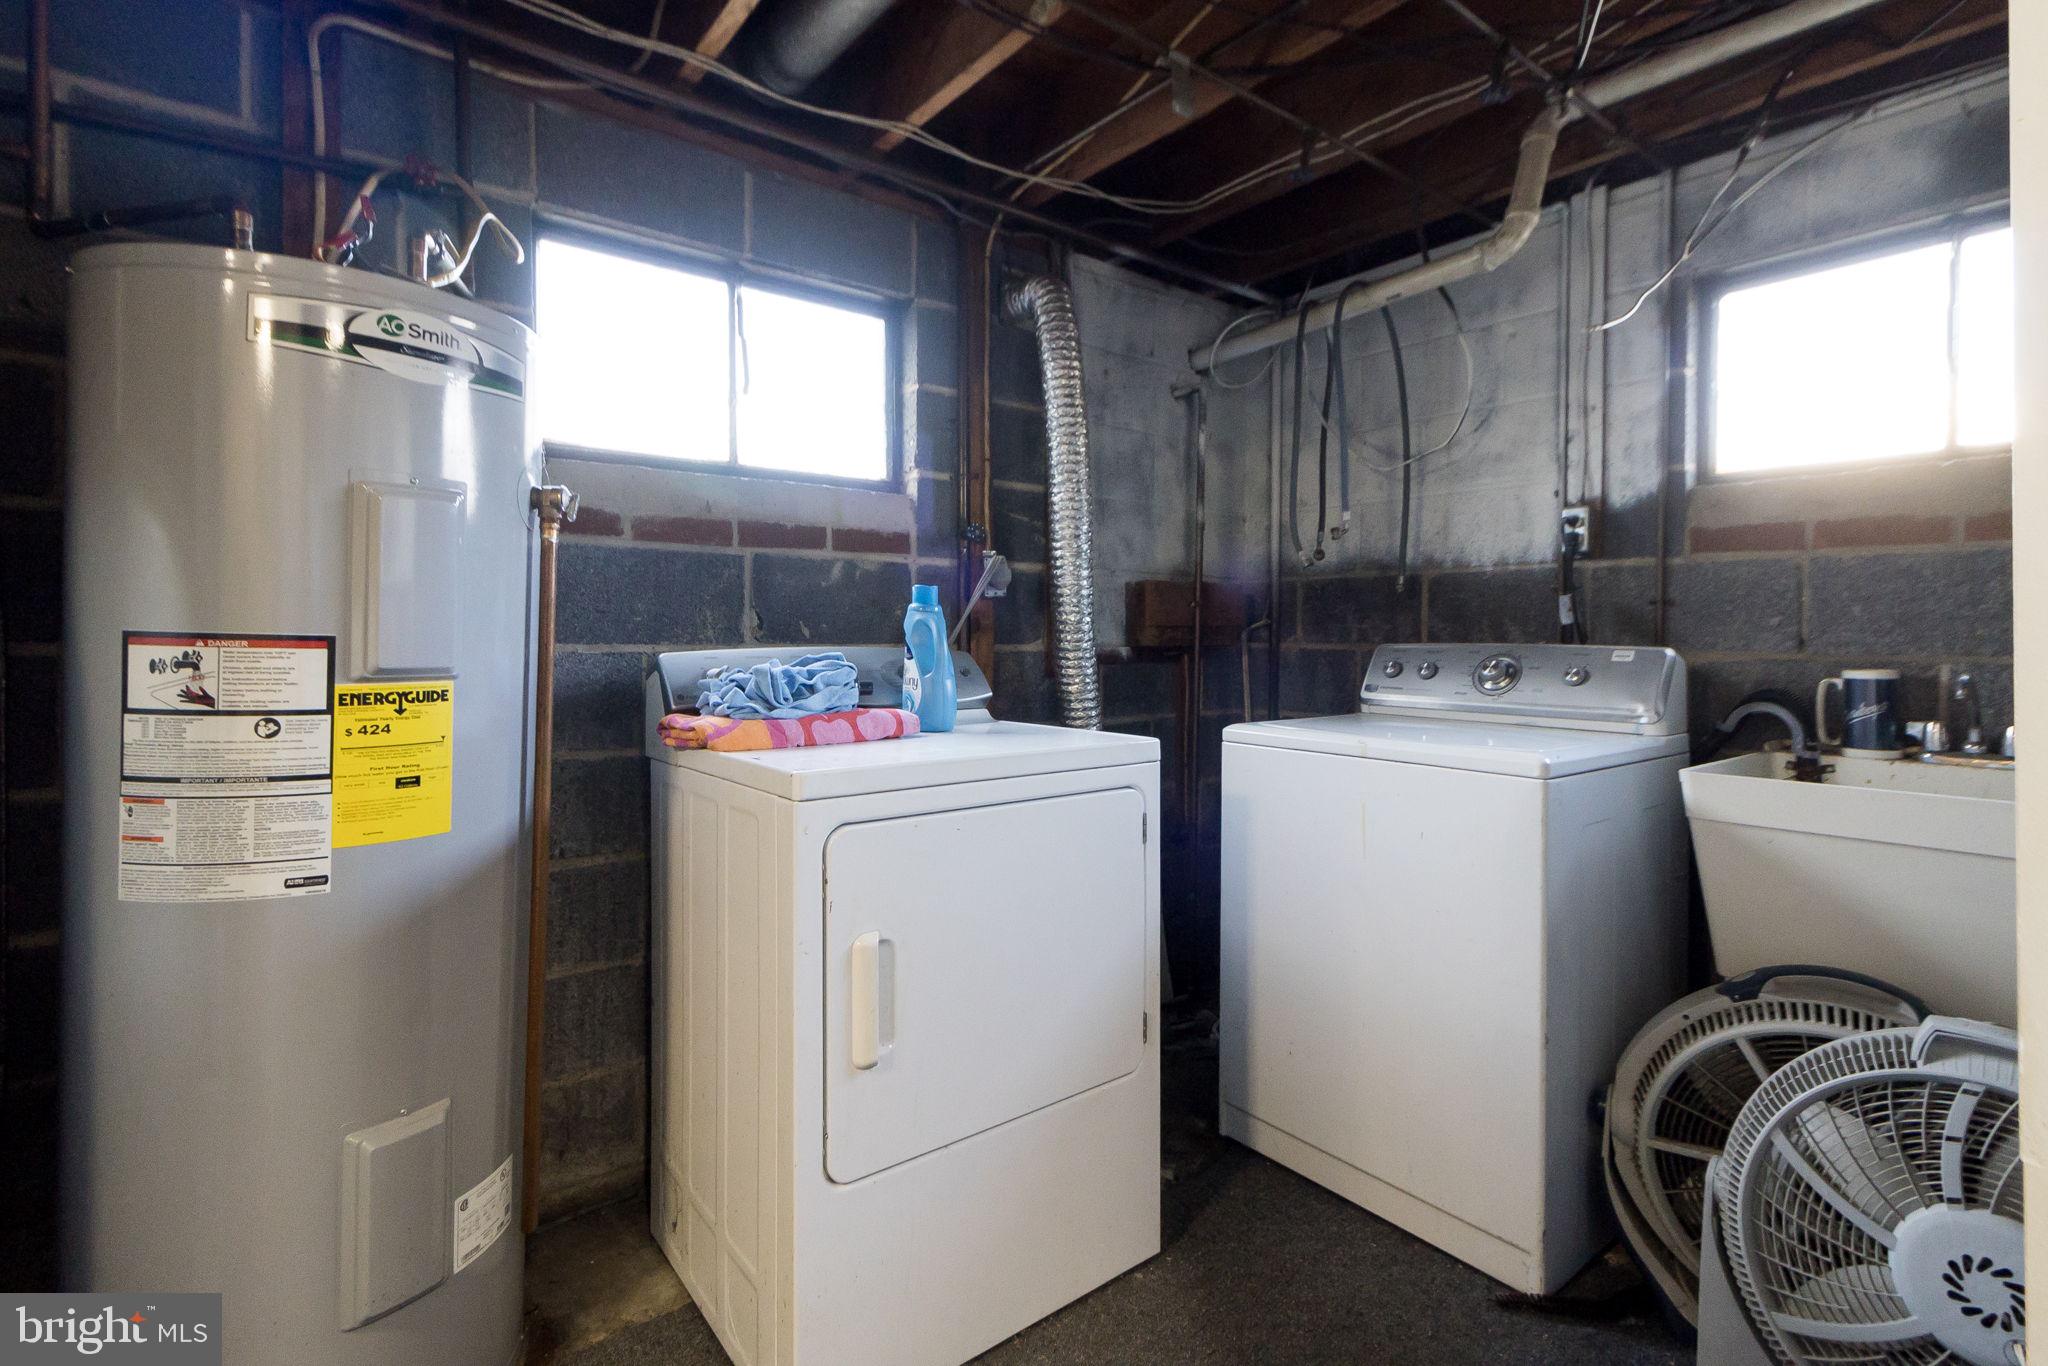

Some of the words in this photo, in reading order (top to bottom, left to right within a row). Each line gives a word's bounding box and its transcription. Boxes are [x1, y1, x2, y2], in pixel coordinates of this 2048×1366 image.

[408, 323, 460, 350] Smith
[207, 639, 249, 648] DANGER
[344, 728, 353, 737] $
[357, 723, 391, 736] 424
